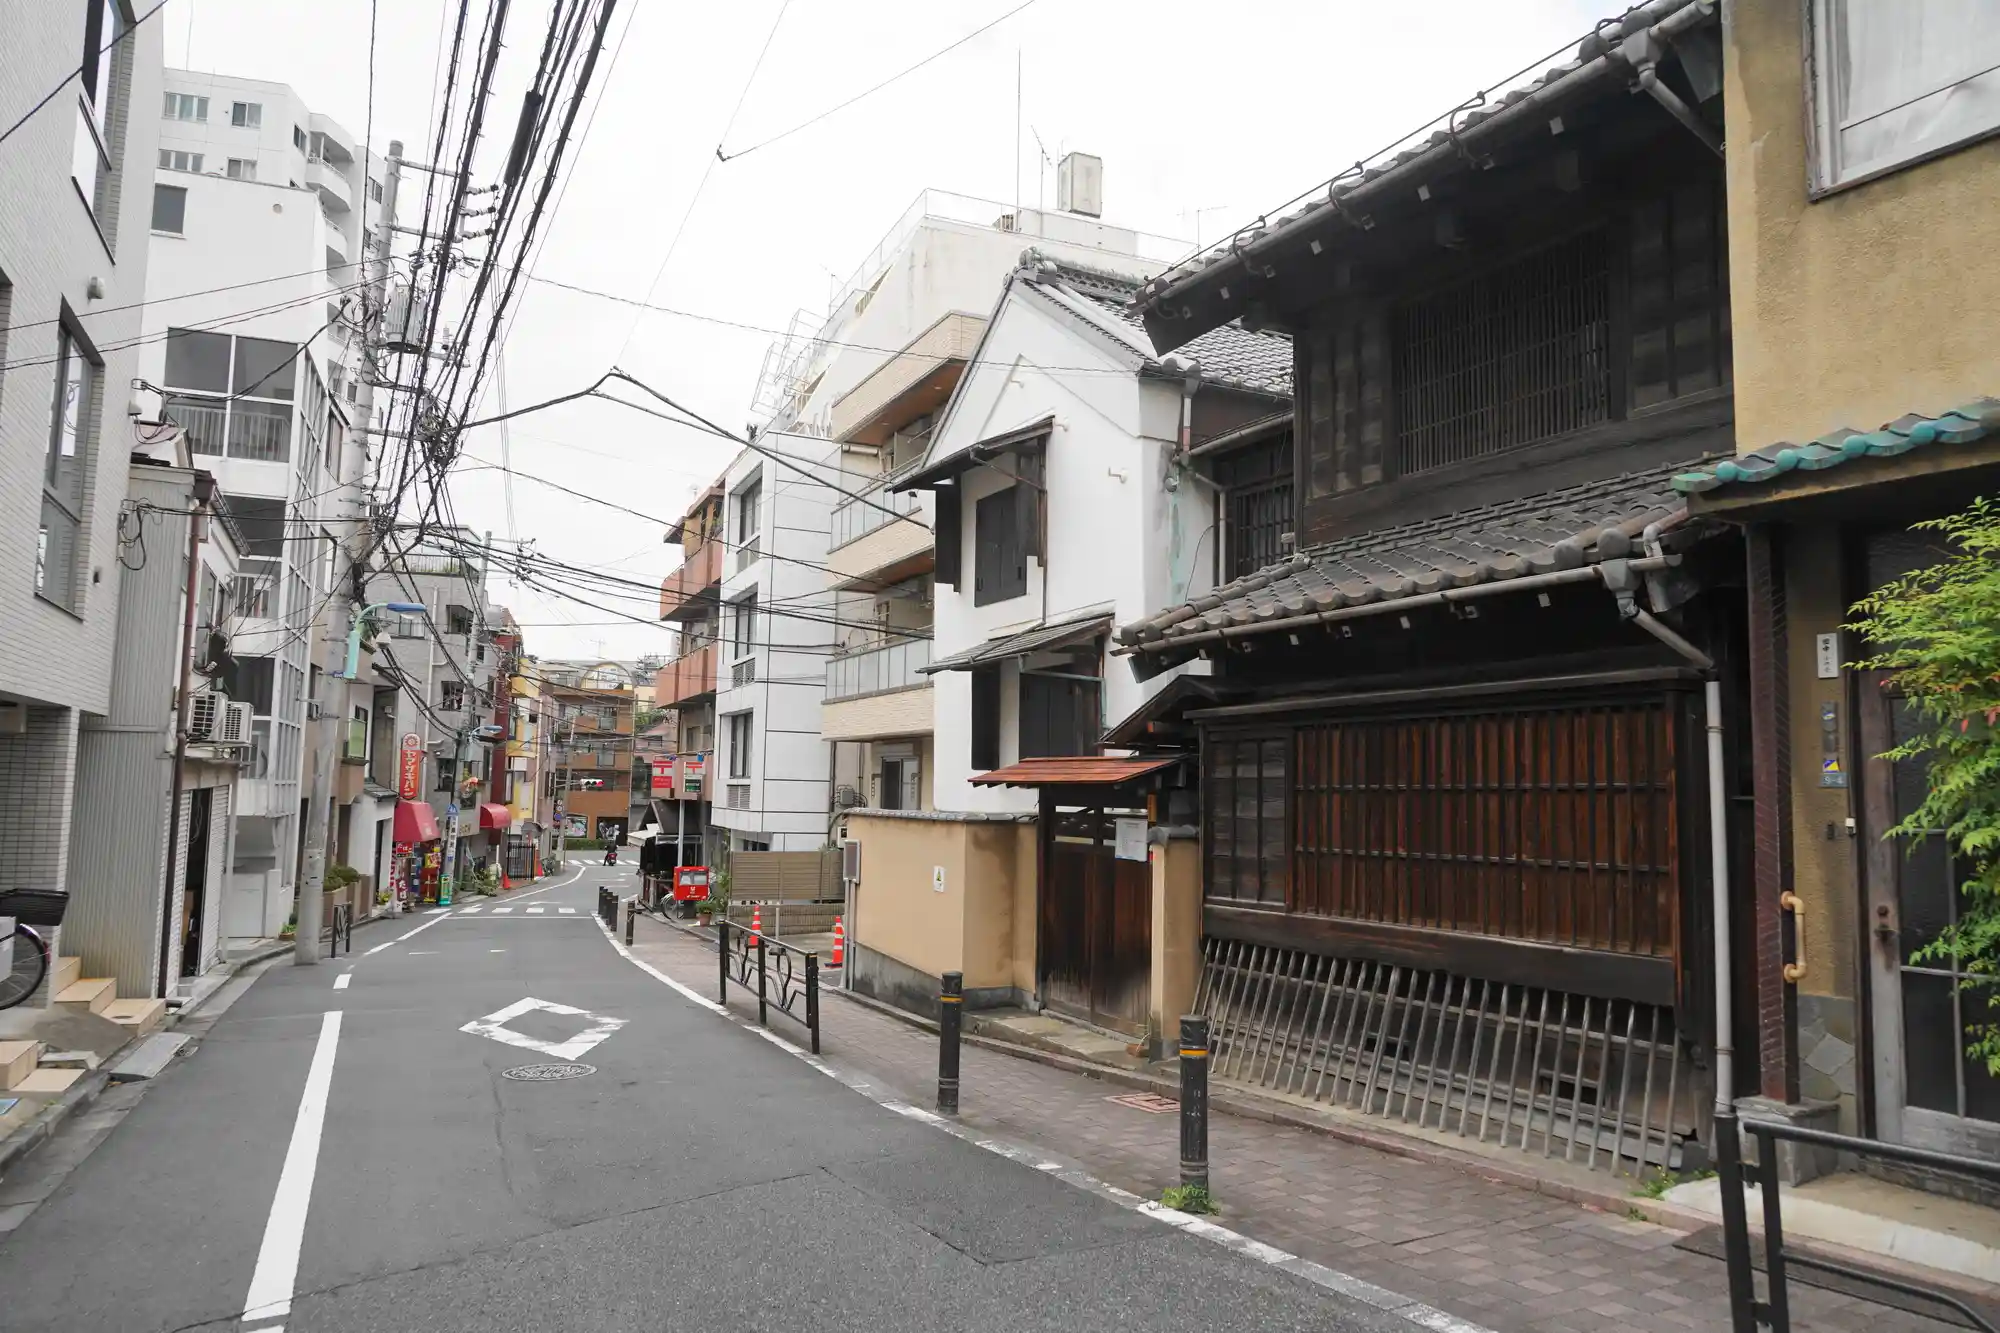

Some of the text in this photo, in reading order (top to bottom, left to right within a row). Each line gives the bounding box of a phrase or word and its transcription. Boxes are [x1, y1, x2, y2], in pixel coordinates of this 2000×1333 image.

[404, 750, 416, 796] ヤマザキパン
[397, 843, 413, 853] たばこ
